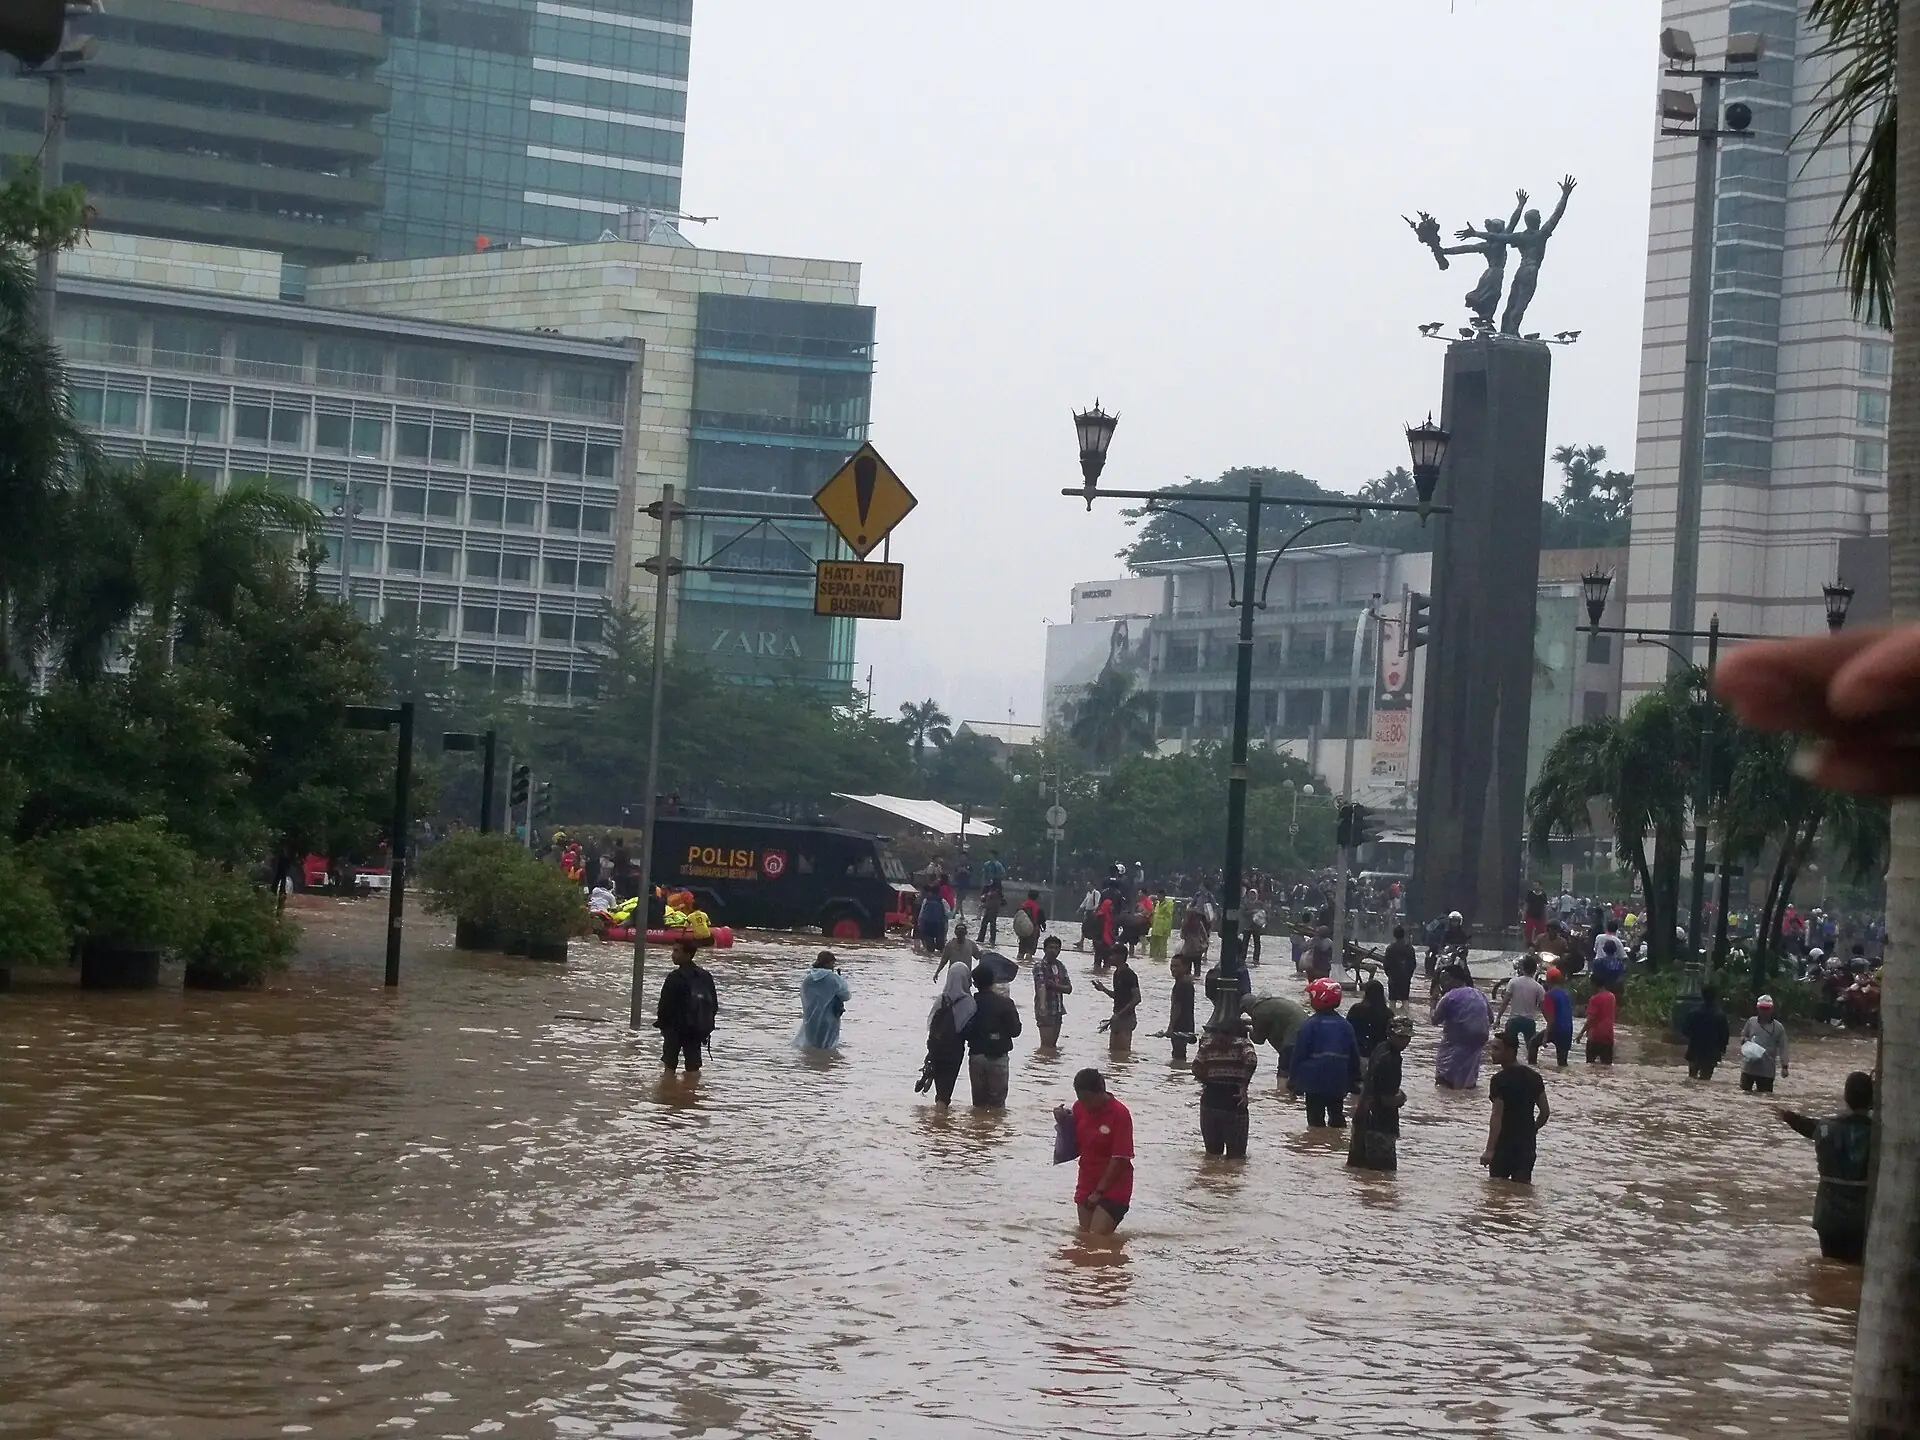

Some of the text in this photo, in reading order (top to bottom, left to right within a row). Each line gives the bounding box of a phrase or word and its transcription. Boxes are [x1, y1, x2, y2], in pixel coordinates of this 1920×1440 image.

[824, 566, 854, 580] HATI
[866, 568, 896, 583] HATI
[820, 581, 897, 599] SEPARATOR
[830, 597, 885, 613] BUSWAY
[711, 627, 802, 657] ZARA
[688, 845, 755, 868] POLISI
